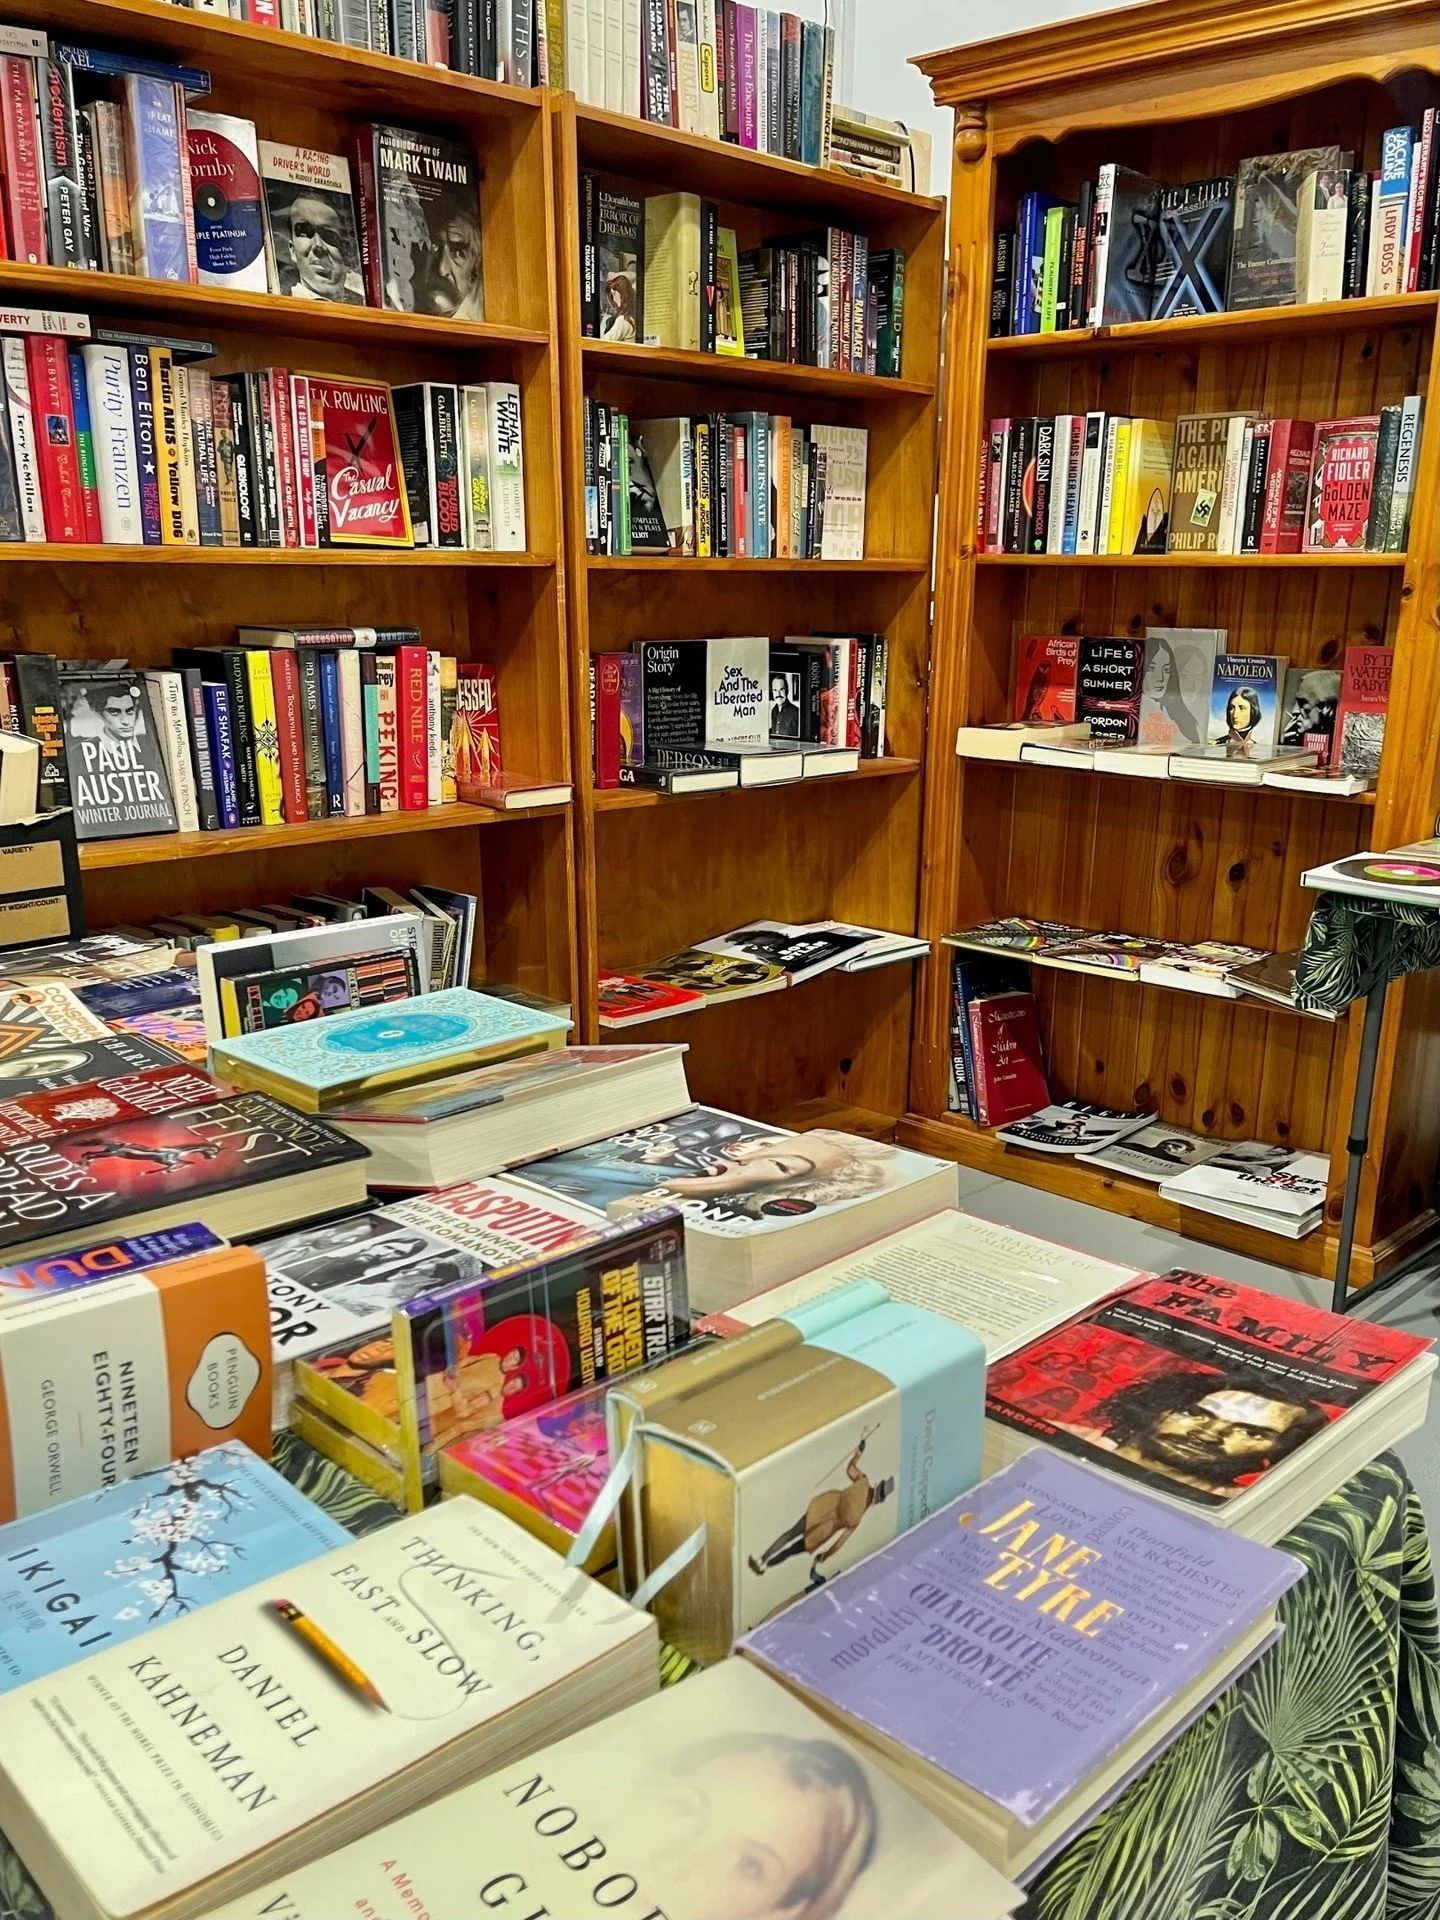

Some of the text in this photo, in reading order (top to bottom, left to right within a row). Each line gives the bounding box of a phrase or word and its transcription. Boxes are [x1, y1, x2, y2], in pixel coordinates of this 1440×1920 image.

[59, 51, 94, 69] KAEL
[681, 51, 697, 113] HUXLEY
[701, 49, 710, 87] Capone
[655, 74, 664, 121] LUCKY
[744, 31, 754, 139] The First Encounter
[49, 69, 69, 166] modernism
[823, 64, 834, 161] PETER BENCHLEY
[295, 148, 330, 164] A RACING
[380, 136, 440, 156] AUTOBIOGRAPHY OF
[380, 148, 468, 184] MARK TWAIN
[1383, 133, 1397, 181] COLLINS
[1394, 133, 1408, 180] JACKIE
[306, 164, 331, 178] WORLD
[60, 187, 74, 253] PETER GAY
[1381, 209, 1397, 275] LADY BOSS
[997, 233, 1007, 272] LARSSON
[893, 255, 903, 332] LEE CHILD
[840, 339, 849, 359] JURY
[853, 299, 864, 359] RAINMAKER
[134, 354, 154, 455] Ben Elton
[159, 357, 176, 445] Martin AMIS
[298, 411, 307, 426] $50
[507, 393, 520, 447] LETHAL
[102, 355, 132, 509] Purity Franzen
[194, 398, 209, 484] HIS NATURAL LIFE
[300, 427, 308, 456] WEEKLY
[437, 395, 448, 458] GALBRAITH
[445, 412, 453, 444] ROBERT
[496, 401, 511, 455] WHITE
[1397, 414, 1416, 483] REGENESIS
[16, 414, 34, 513] Terry McMillan
[302, 458, 310, 478] SHOP
[1065, 427, 1080, 527] CHAOS UNDER HEAVEN
[1326, 461, 1371, 481] FIDLER
[1331, 447, 1369, 461] RICHARD
[167, 461, 183, 538] Yellow DOG
[236, 454, 250, 520] QUIRKOLOGY
[331, 463, 396, 501] Casual
[472, 478, 480, 511] GRAVE
[701, 458, 709, 499] HIGGINS
[329, 497, 400, 528] Vacancy
[438, 481, 451, 533] BLOOD
[448, 474, 459, 532] TROUBLED
[1328, 502, 1361, 522] MAZE
[1170, 533, 1211, 550] PHILIP
[647, 646, 679, 662] Origin
[1046, 648, 1077, 657] Birds of
[1048, 640, 1077, 649] African
[1057, 656, 1077, 668] Prey
[1363, 654, 1378, 665] BY
[646, 661, 676, 676] Story
[718, 677, 759, 692] And The
[724, 666, 744, 680] Sex
[1081, 663, 1135, 676] A SHORT
[1082, 678, 1132, 692] SUMMER
[1217, 663, 1274, 679] NAPOLEON
[232, 656, 248, 742] RUDYARD KIPLING
[410, 667, 423, 744] RED NILE
[714, 690, 763, 706] Liberated
[732, 705, 756, 718] Man
[216, 690, 231, 759] ELIF SHAFAK
[427, 698, 437, 758] anthony kiedis
[1083, 716, 1128, 728] GORDON
[80, 740, 145, 773] PAUL
[168, 683, 191, 816] Tiny Bit Marvellous DAWN FRENCH
[378, 710, 397, 801] PEKING
[76, 770, 165, 808] AUSTER
[77, 802, 173, 825] WINTER JOURNAL
[1, 844, 35, 855] VARIETY:
[7, 897, 61, 912] WEIGHT/COUNT:
[157, 1073, 224, 1103] NEIL
[953, 1057, 965, 1083] BOOK
[168, 1102, 313, 1165] FEIST
[5, 1142, 117, 1211] RIDES A
[1162, 1268, 1238, 1300] The
[576, 1288, 592, 1348] HOWARD
[206, 1361, 220, 1411] BOOKS
[224, 1347, 245, 1411] PENGUIN
[118, 1359, 140, 1464] NINETEEN
[41, 1378, 64, 1497] GEORGE ORWELL
[957, 1497, 1104, 1581] JANE
[1126, 1524, 1216, 1568] Thornfield
[8, 1547, 113, 1648] IKIGAI
[332, 1562, 402, 1612] FAST
[400, 1536, 546, 1662] THINKING,
[982, 1550, 1126, 1640] EYRE
[829, 1605, 928, 1672] morality
[907, 1581, 1062, 1670] CHARLOTTE
[1126, 1608, 1171, 1635] DUTY
[1024, 1617, 1153, 1686] Madwoman
[216, 1644, 322, 1749] DANIEL
[128, 1654, 278, 1813] KAHNEMAN
